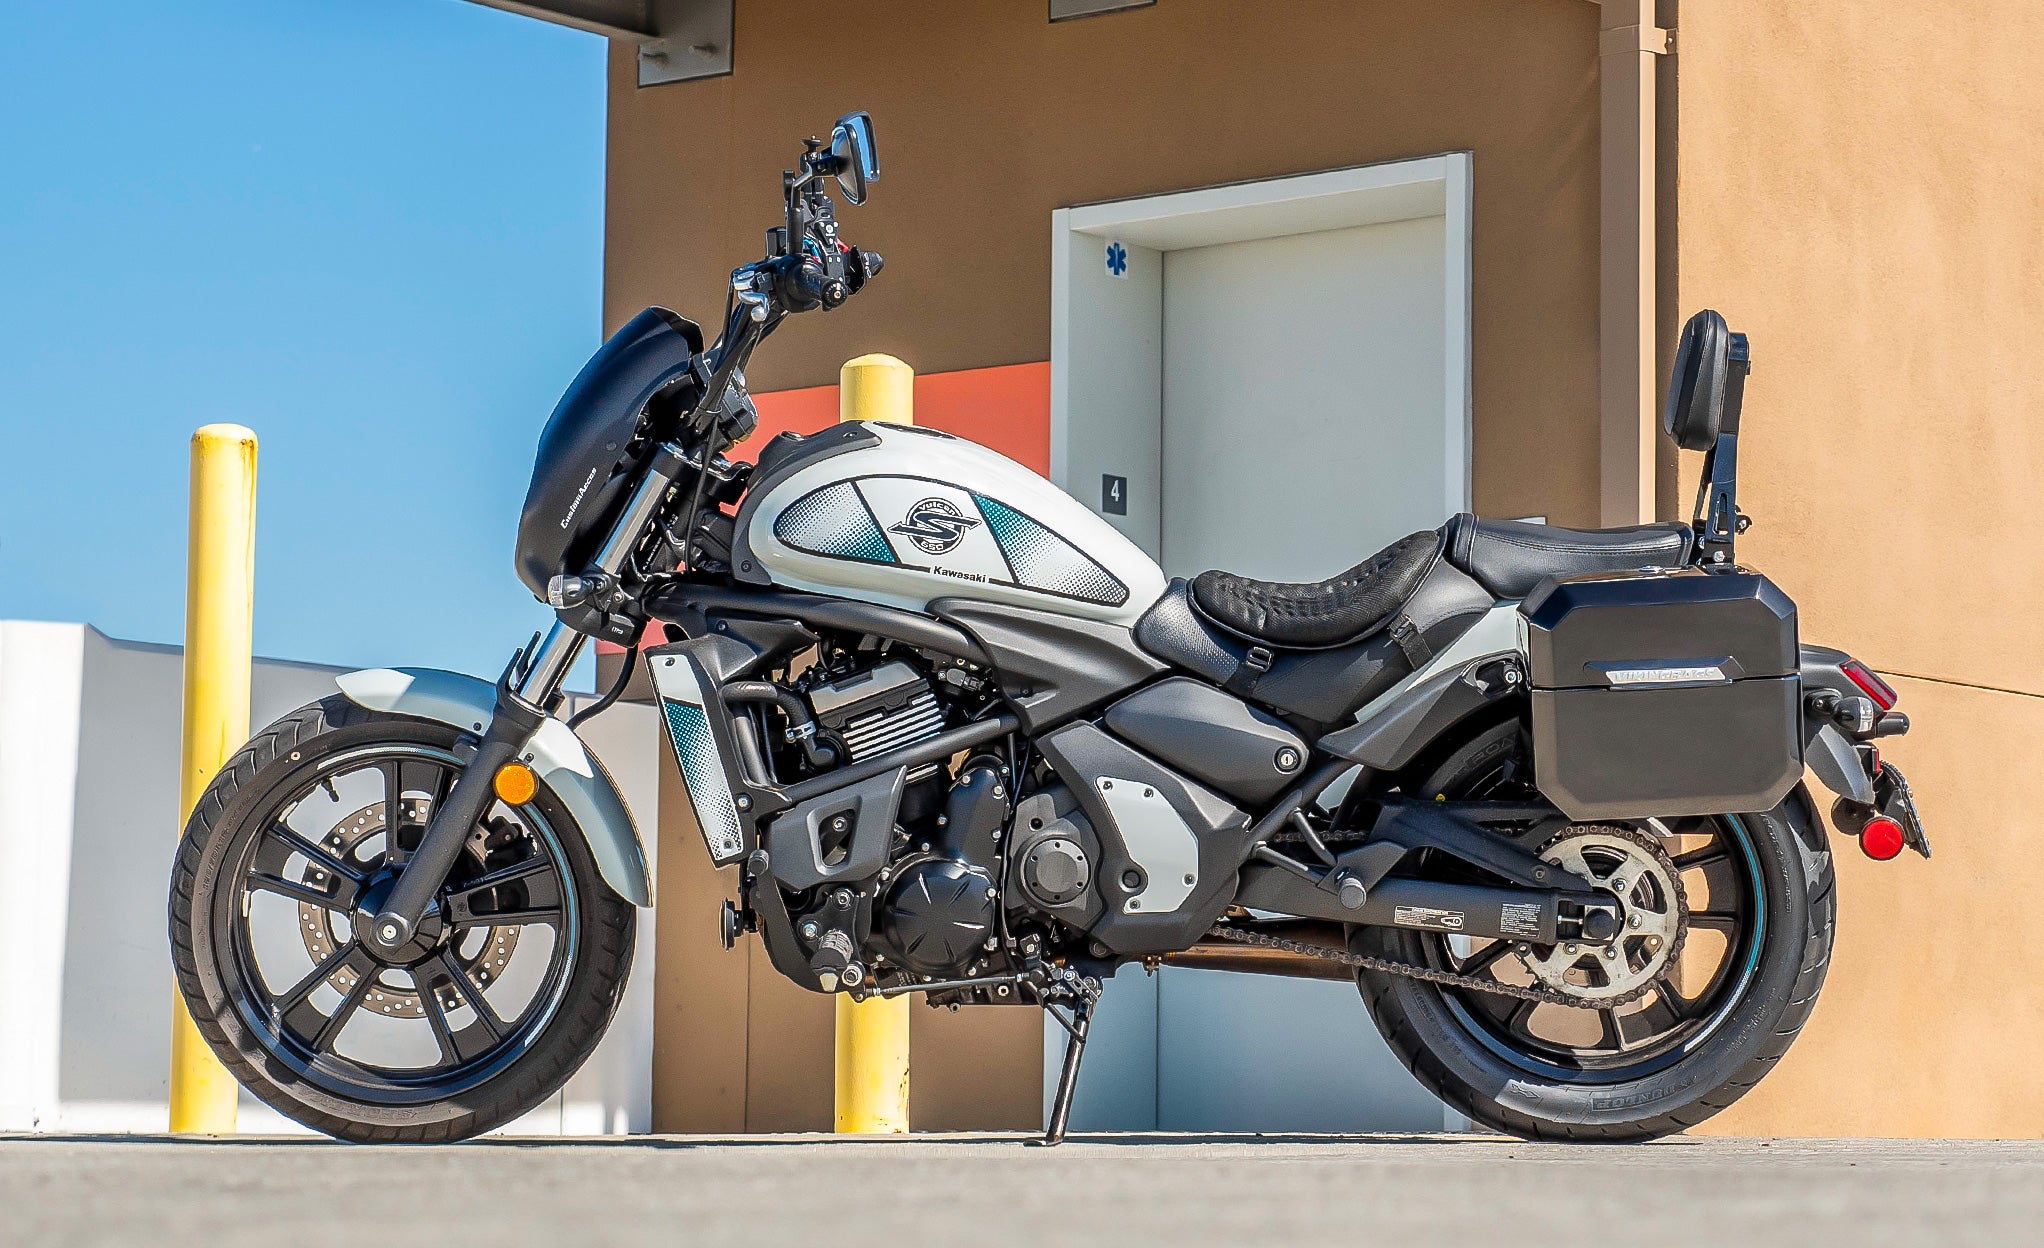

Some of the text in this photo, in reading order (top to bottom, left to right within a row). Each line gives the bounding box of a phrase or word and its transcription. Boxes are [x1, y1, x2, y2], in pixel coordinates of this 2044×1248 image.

[1110, 479, 1120, 502] 4
[921, 540, 944, 551] 650
[933, 565, 987, 583] Kawasaki
